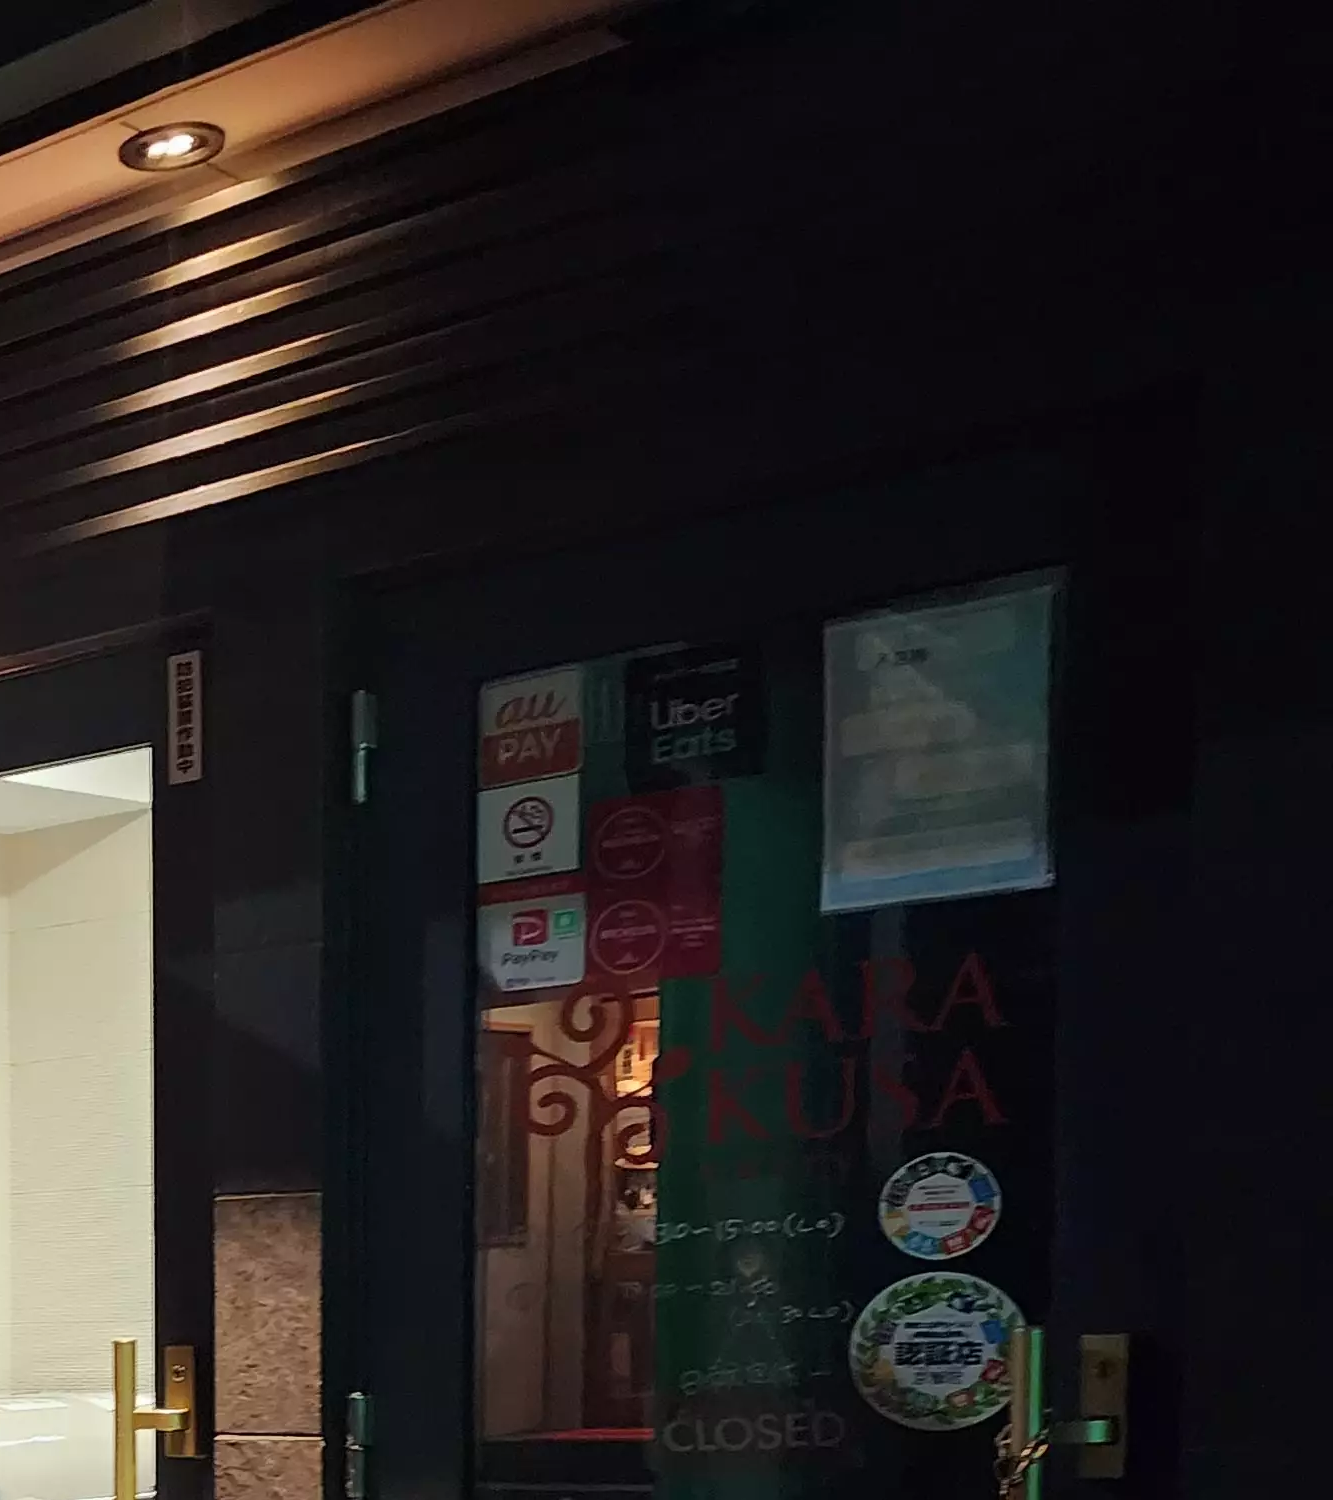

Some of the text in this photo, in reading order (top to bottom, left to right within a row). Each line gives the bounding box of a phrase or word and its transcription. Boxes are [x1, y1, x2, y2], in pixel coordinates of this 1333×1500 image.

[495, 690, 567, 729] au
[649, 691, 741, 730] Uber
[497, 728, 562, 766] PAY
[650, 727, 738, 766] Eats
[501, 948, 560, 967] PayPay
[708, 949, 1017, 1055] KARA
[706, 1046, 1010, 1145] KUSA
[662, 1409, 845, 1455] CLOSED
